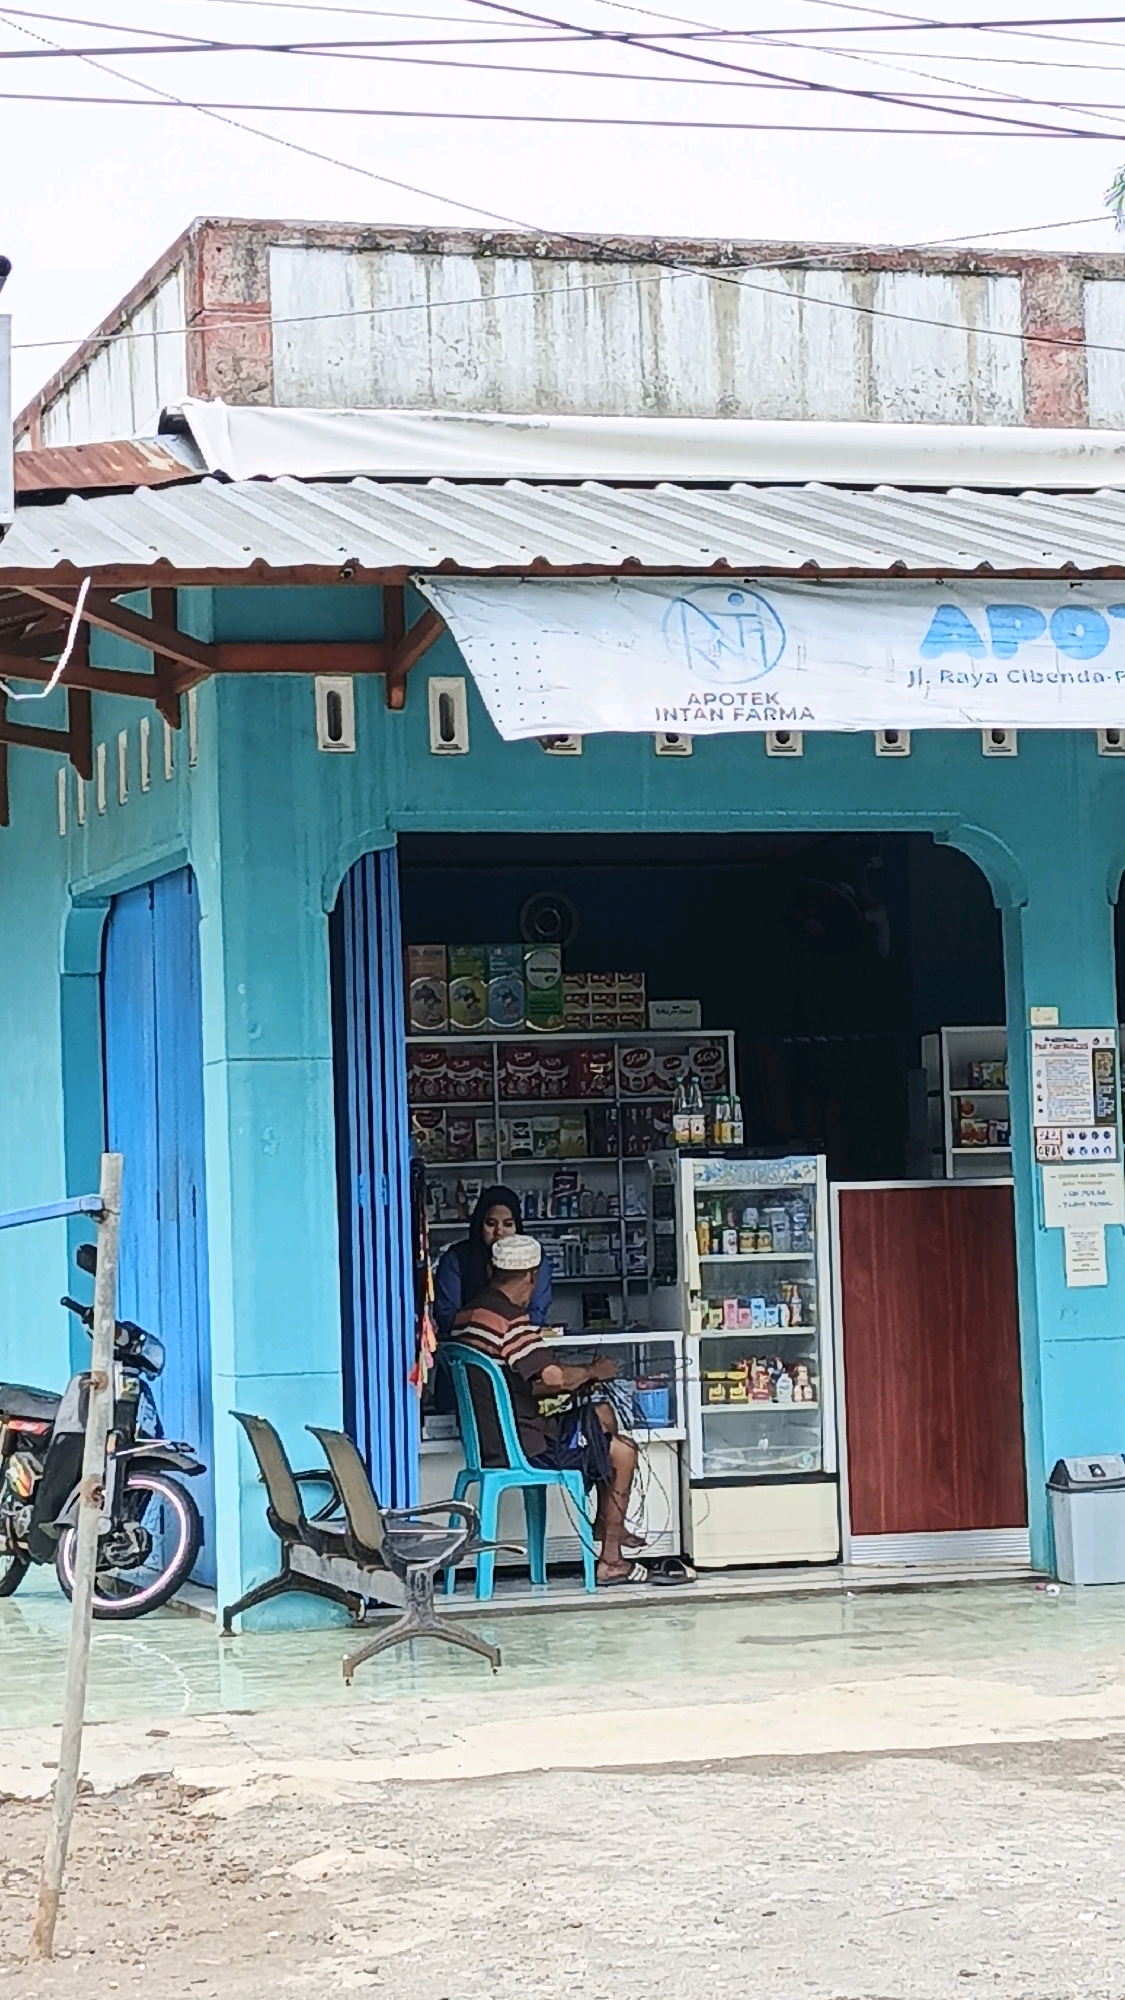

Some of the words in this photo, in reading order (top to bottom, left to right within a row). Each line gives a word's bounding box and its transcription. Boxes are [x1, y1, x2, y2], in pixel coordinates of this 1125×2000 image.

[919, 603, 1125, 660] APO
[940, 669, 998, 688] Raya
[687, 692, 780, 706] APOTEK
[655, 706, 724, 722] INTAN
[733, 706, 816, 722] FARMA
